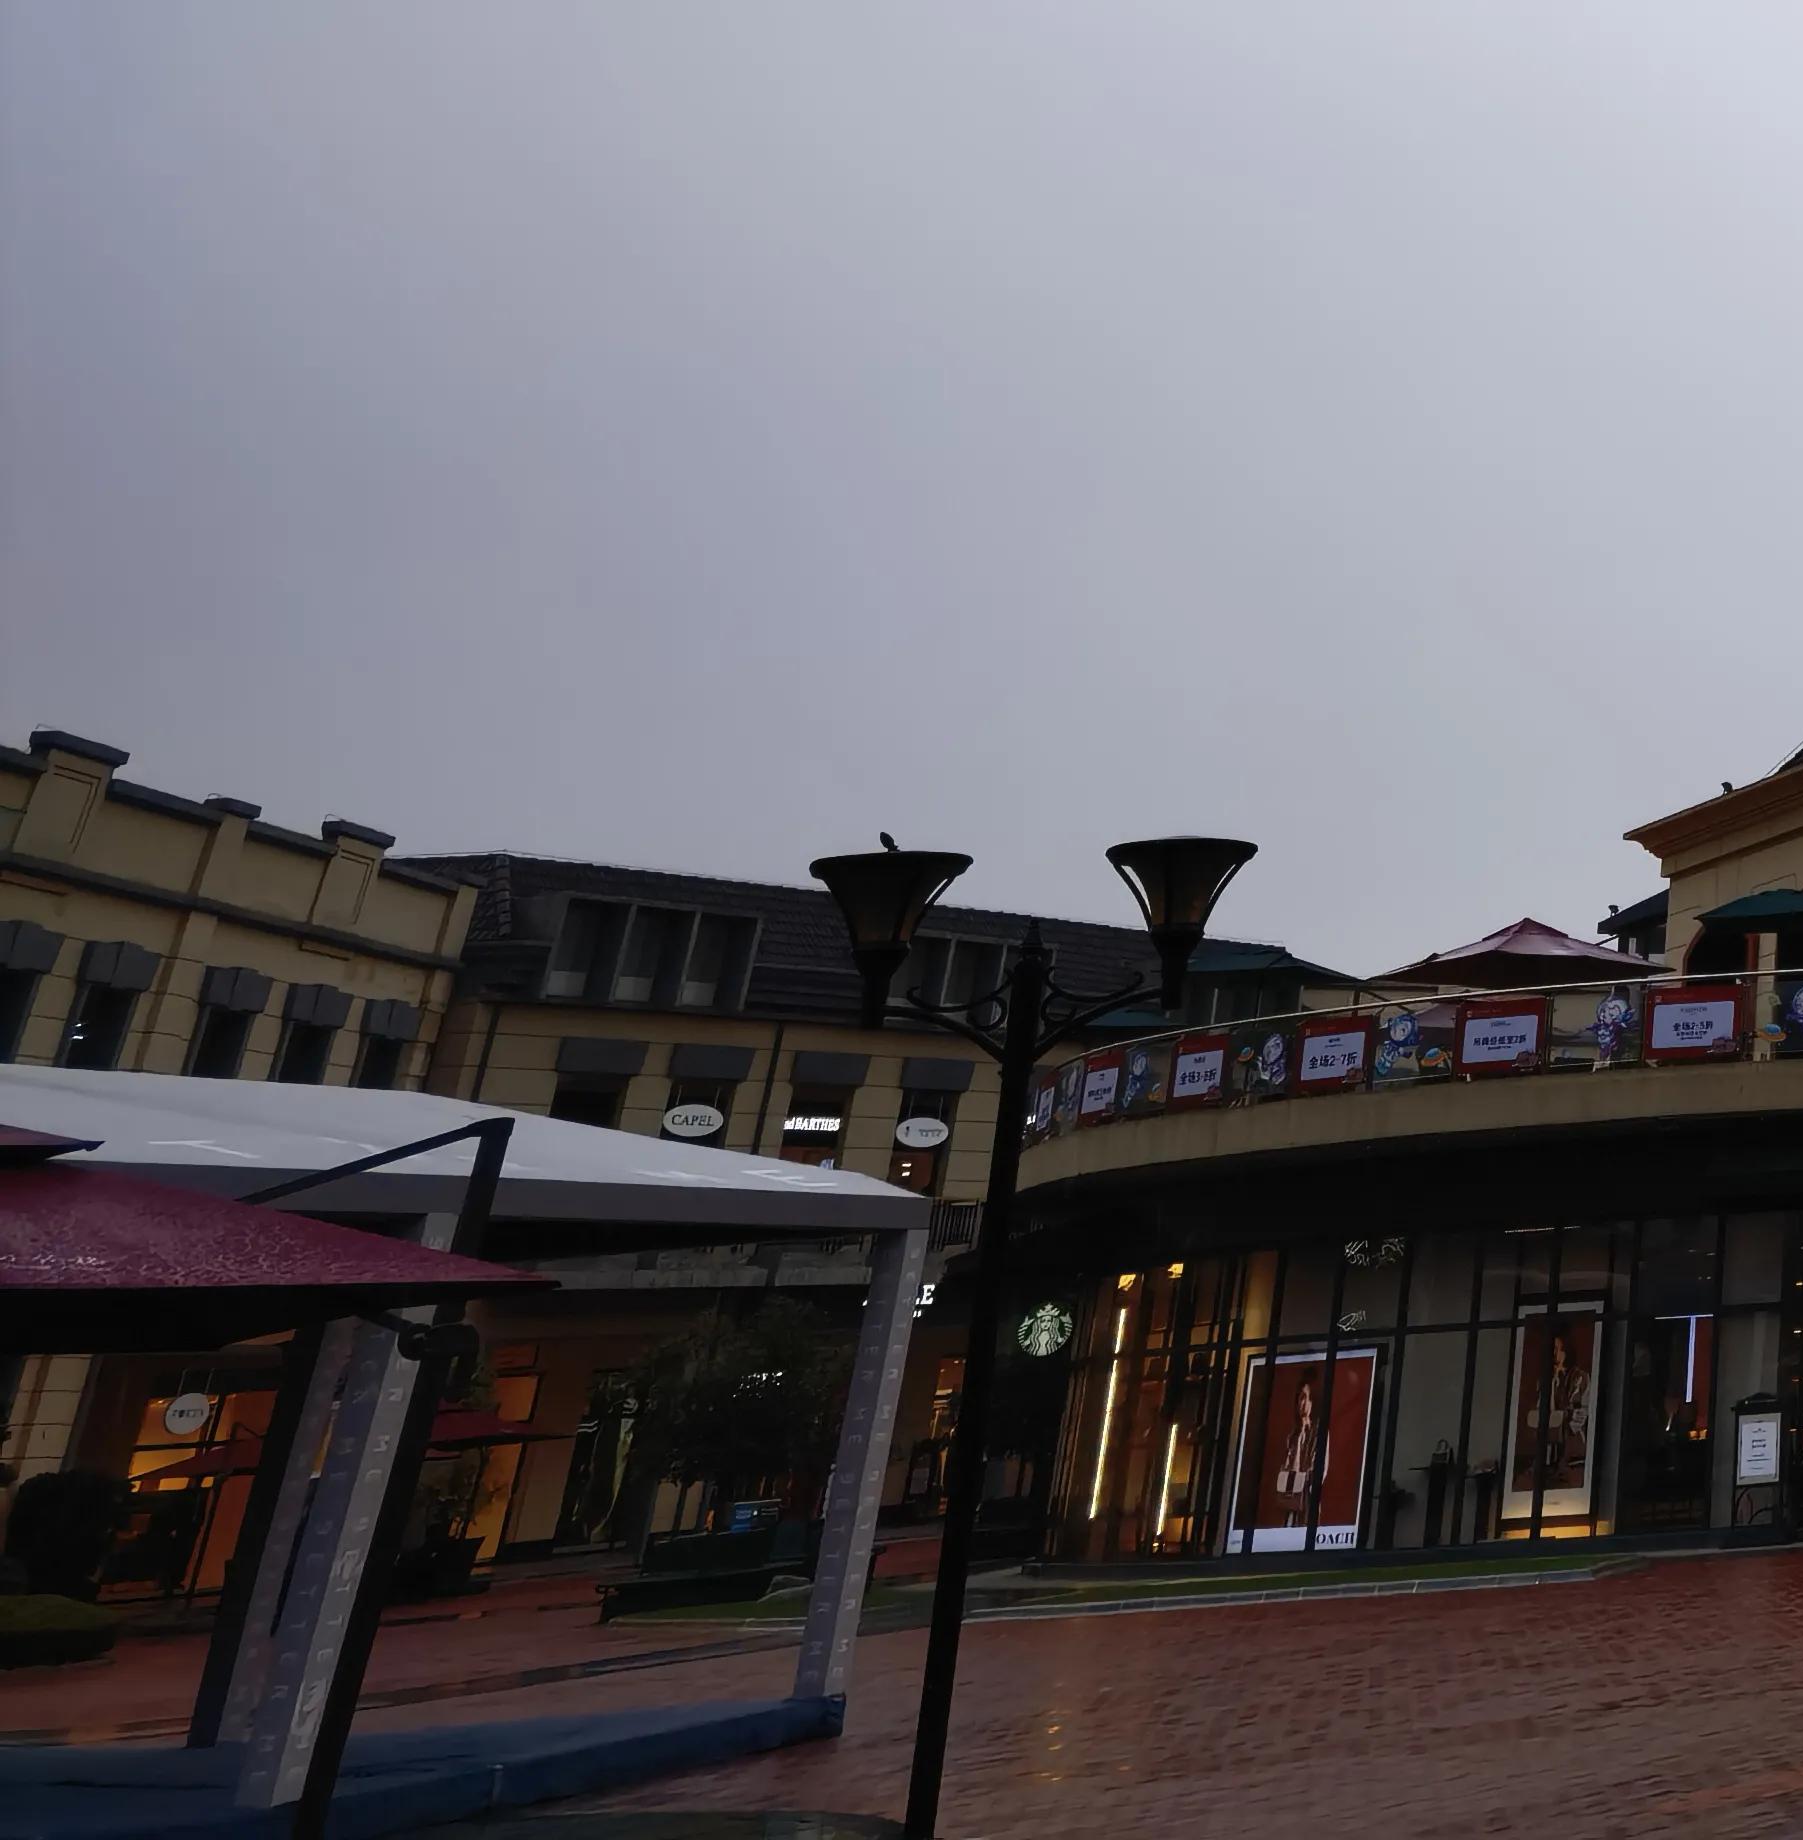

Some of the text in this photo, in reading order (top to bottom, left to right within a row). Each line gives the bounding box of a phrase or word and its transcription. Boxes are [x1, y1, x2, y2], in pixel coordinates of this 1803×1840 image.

[1308, 1051, 1358, 1070] 全场2-7折
[671, 1113, 715, 1127] CAPEL
[795, 1117, 840, 1132] BARTHES
